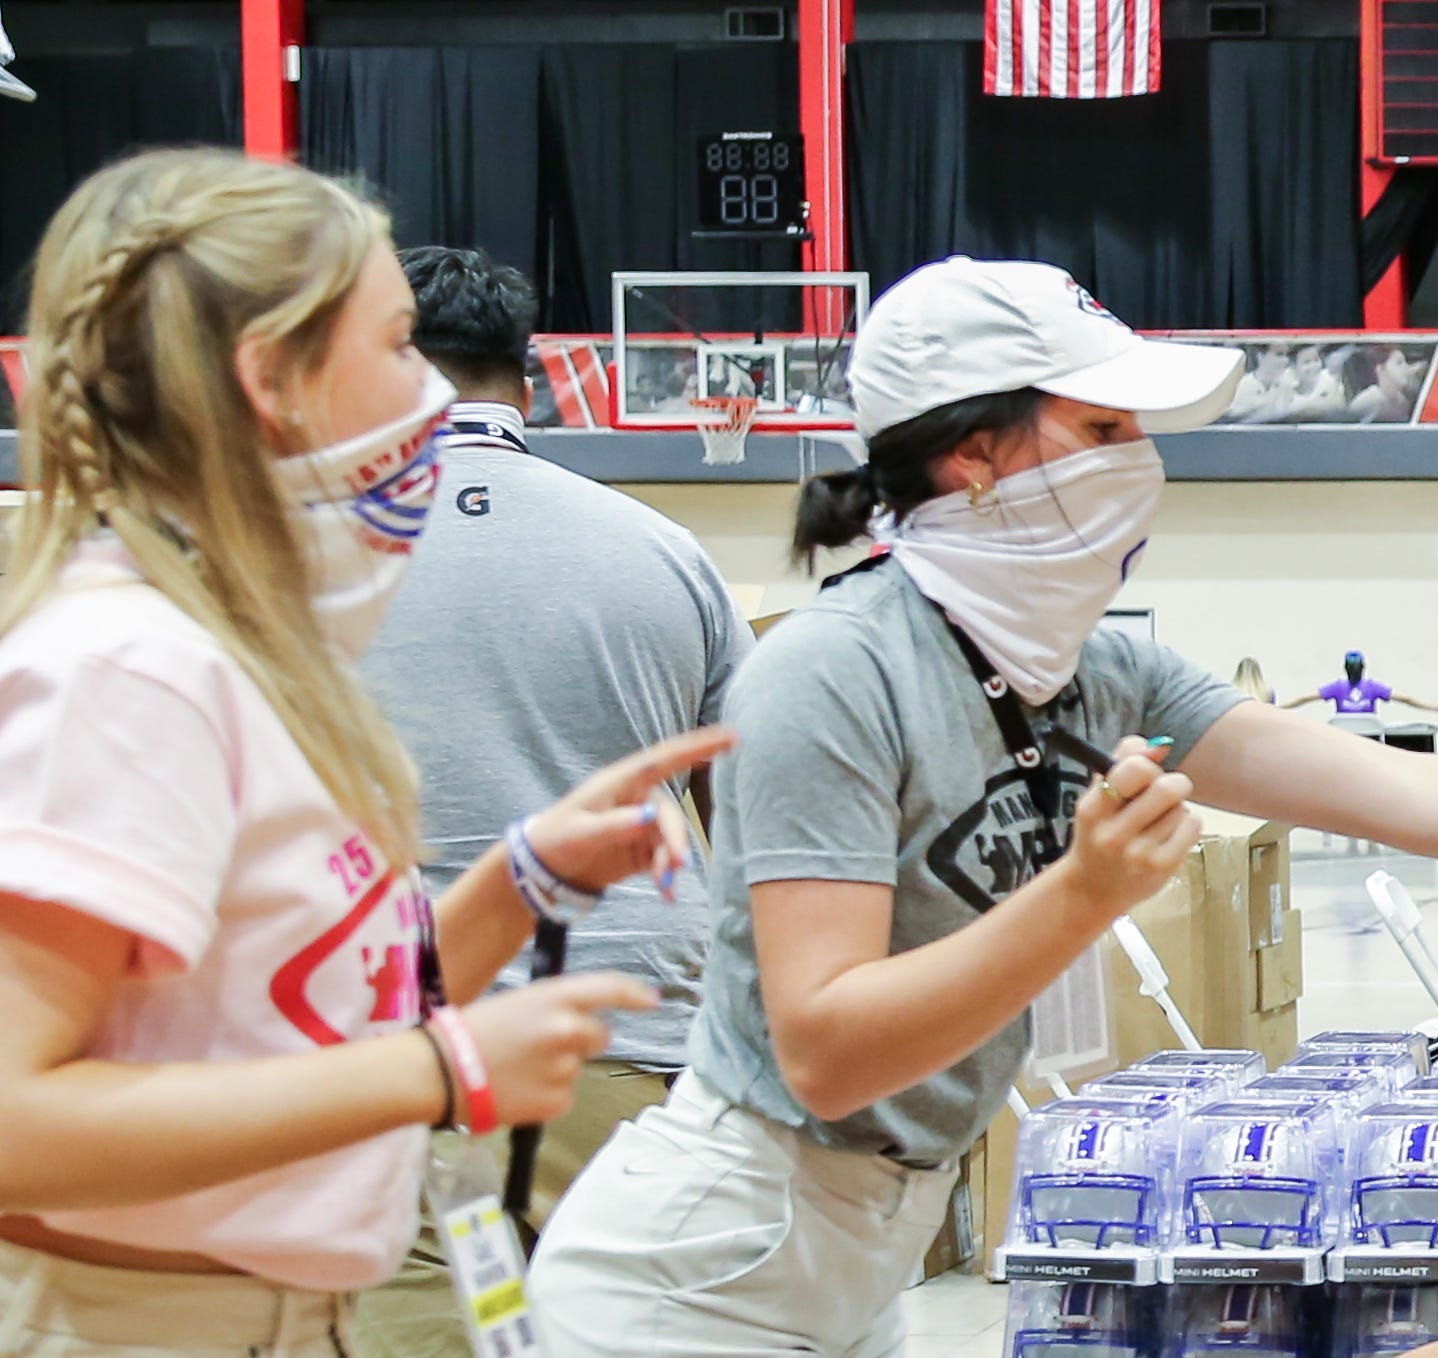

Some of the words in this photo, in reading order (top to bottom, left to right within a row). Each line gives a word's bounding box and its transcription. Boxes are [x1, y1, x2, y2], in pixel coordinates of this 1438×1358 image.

[1007, 1264, 1033, 1274] MINI
[1034, 1265, 1091, 1276] HELMET
[1174, 1268, 1200, 1278] MINI
[1202, 1268, 1259, 1278] HELMET
[1345, 1267, 1371, 1277] MINI
[1373, 1267, 1430, 1277] HELMET
